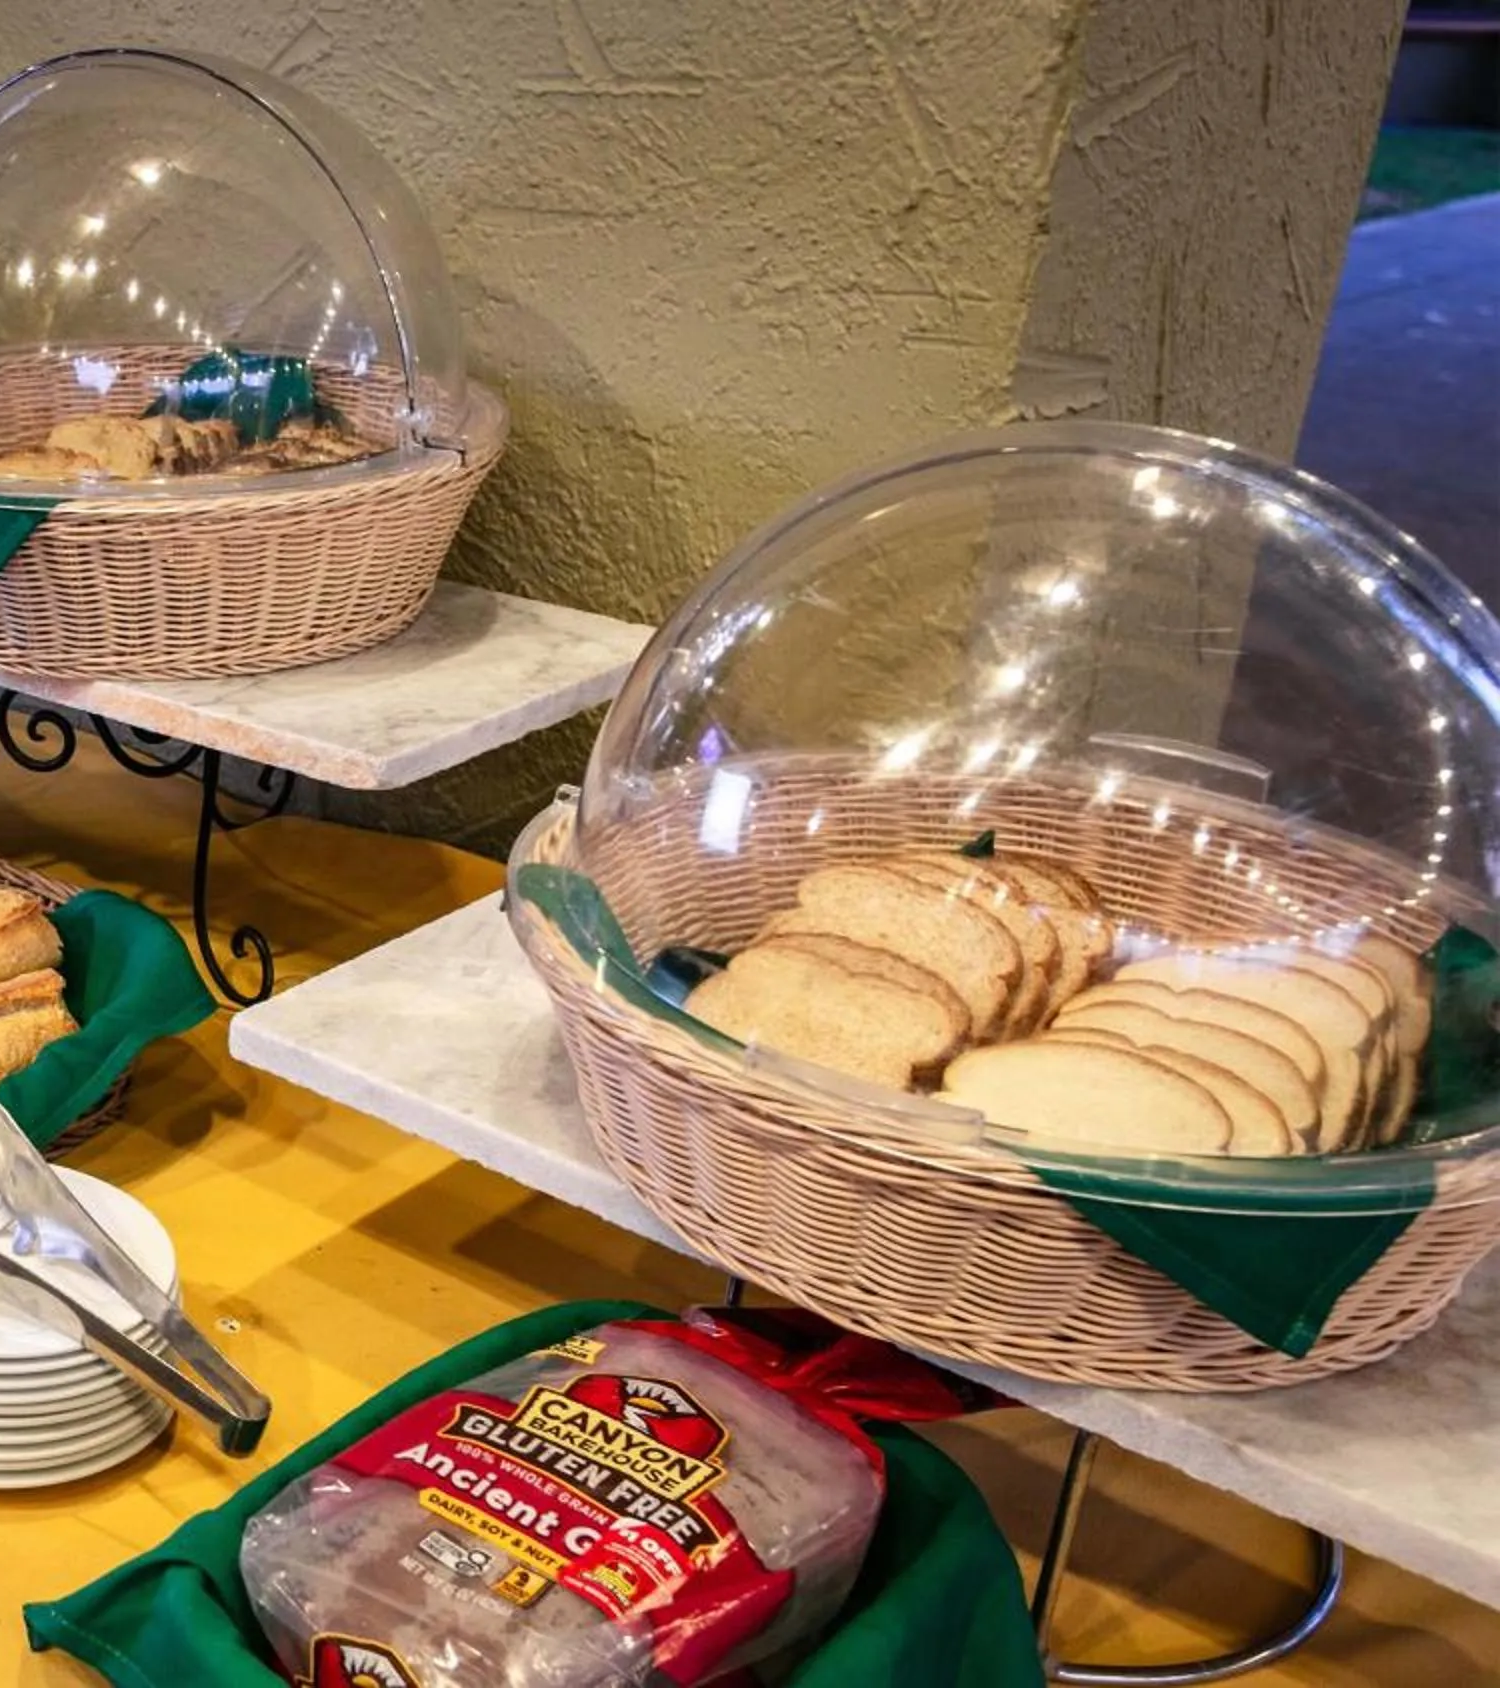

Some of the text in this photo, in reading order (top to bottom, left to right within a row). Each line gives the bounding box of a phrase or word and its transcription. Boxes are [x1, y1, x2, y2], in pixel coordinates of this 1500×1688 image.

[462, 1413, 612, 1490] GLUTEN
[606, 1479, 703, 1546] FREE
[528, 1416, 681, 1493] BAKEHOUSE
[539, 1399, 702, 1482] CANYON
[394, 1442, 560, 1537] Ancient
[455, 1441, 611, 1526] 100% WHOLE GRAIN
[427, 1493, 476, 1525] DAIRY,
[478, 1519, 511, 1540] SOY
[523, 1545, 558, 1567] NUT
